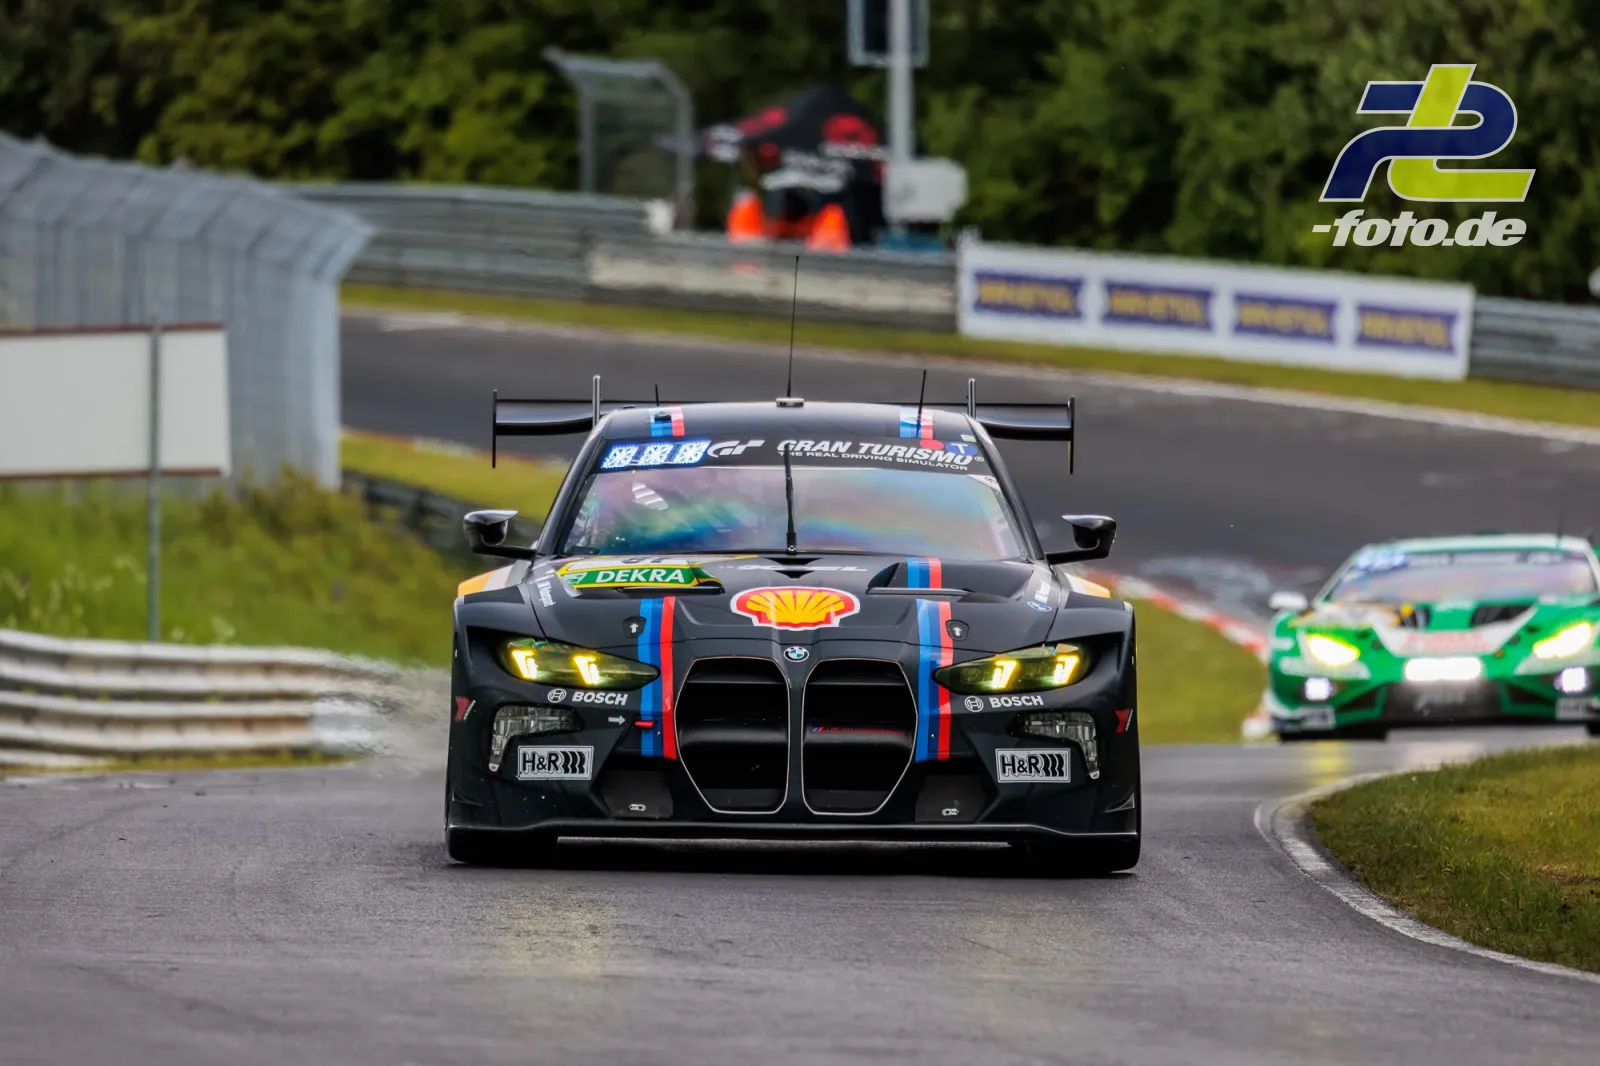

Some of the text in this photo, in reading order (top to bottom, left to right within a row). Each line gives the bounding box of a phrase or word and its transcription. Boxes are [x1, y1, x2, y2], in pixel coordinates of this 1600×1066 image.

[777, 440, 973, 465] GRAN TURISMO
[842, 453, 892, 462] DRIVING
[896, 458, 968, 471] SIMULATOR
[595, 567, 685, 584] DEKRA
[572, 691, 628, 706] BOSCH
[988, 695, 1044, 709] BOSCH
[522, 752, 560, 772] H&R
[1001, 755, 1041, 775] H&R
